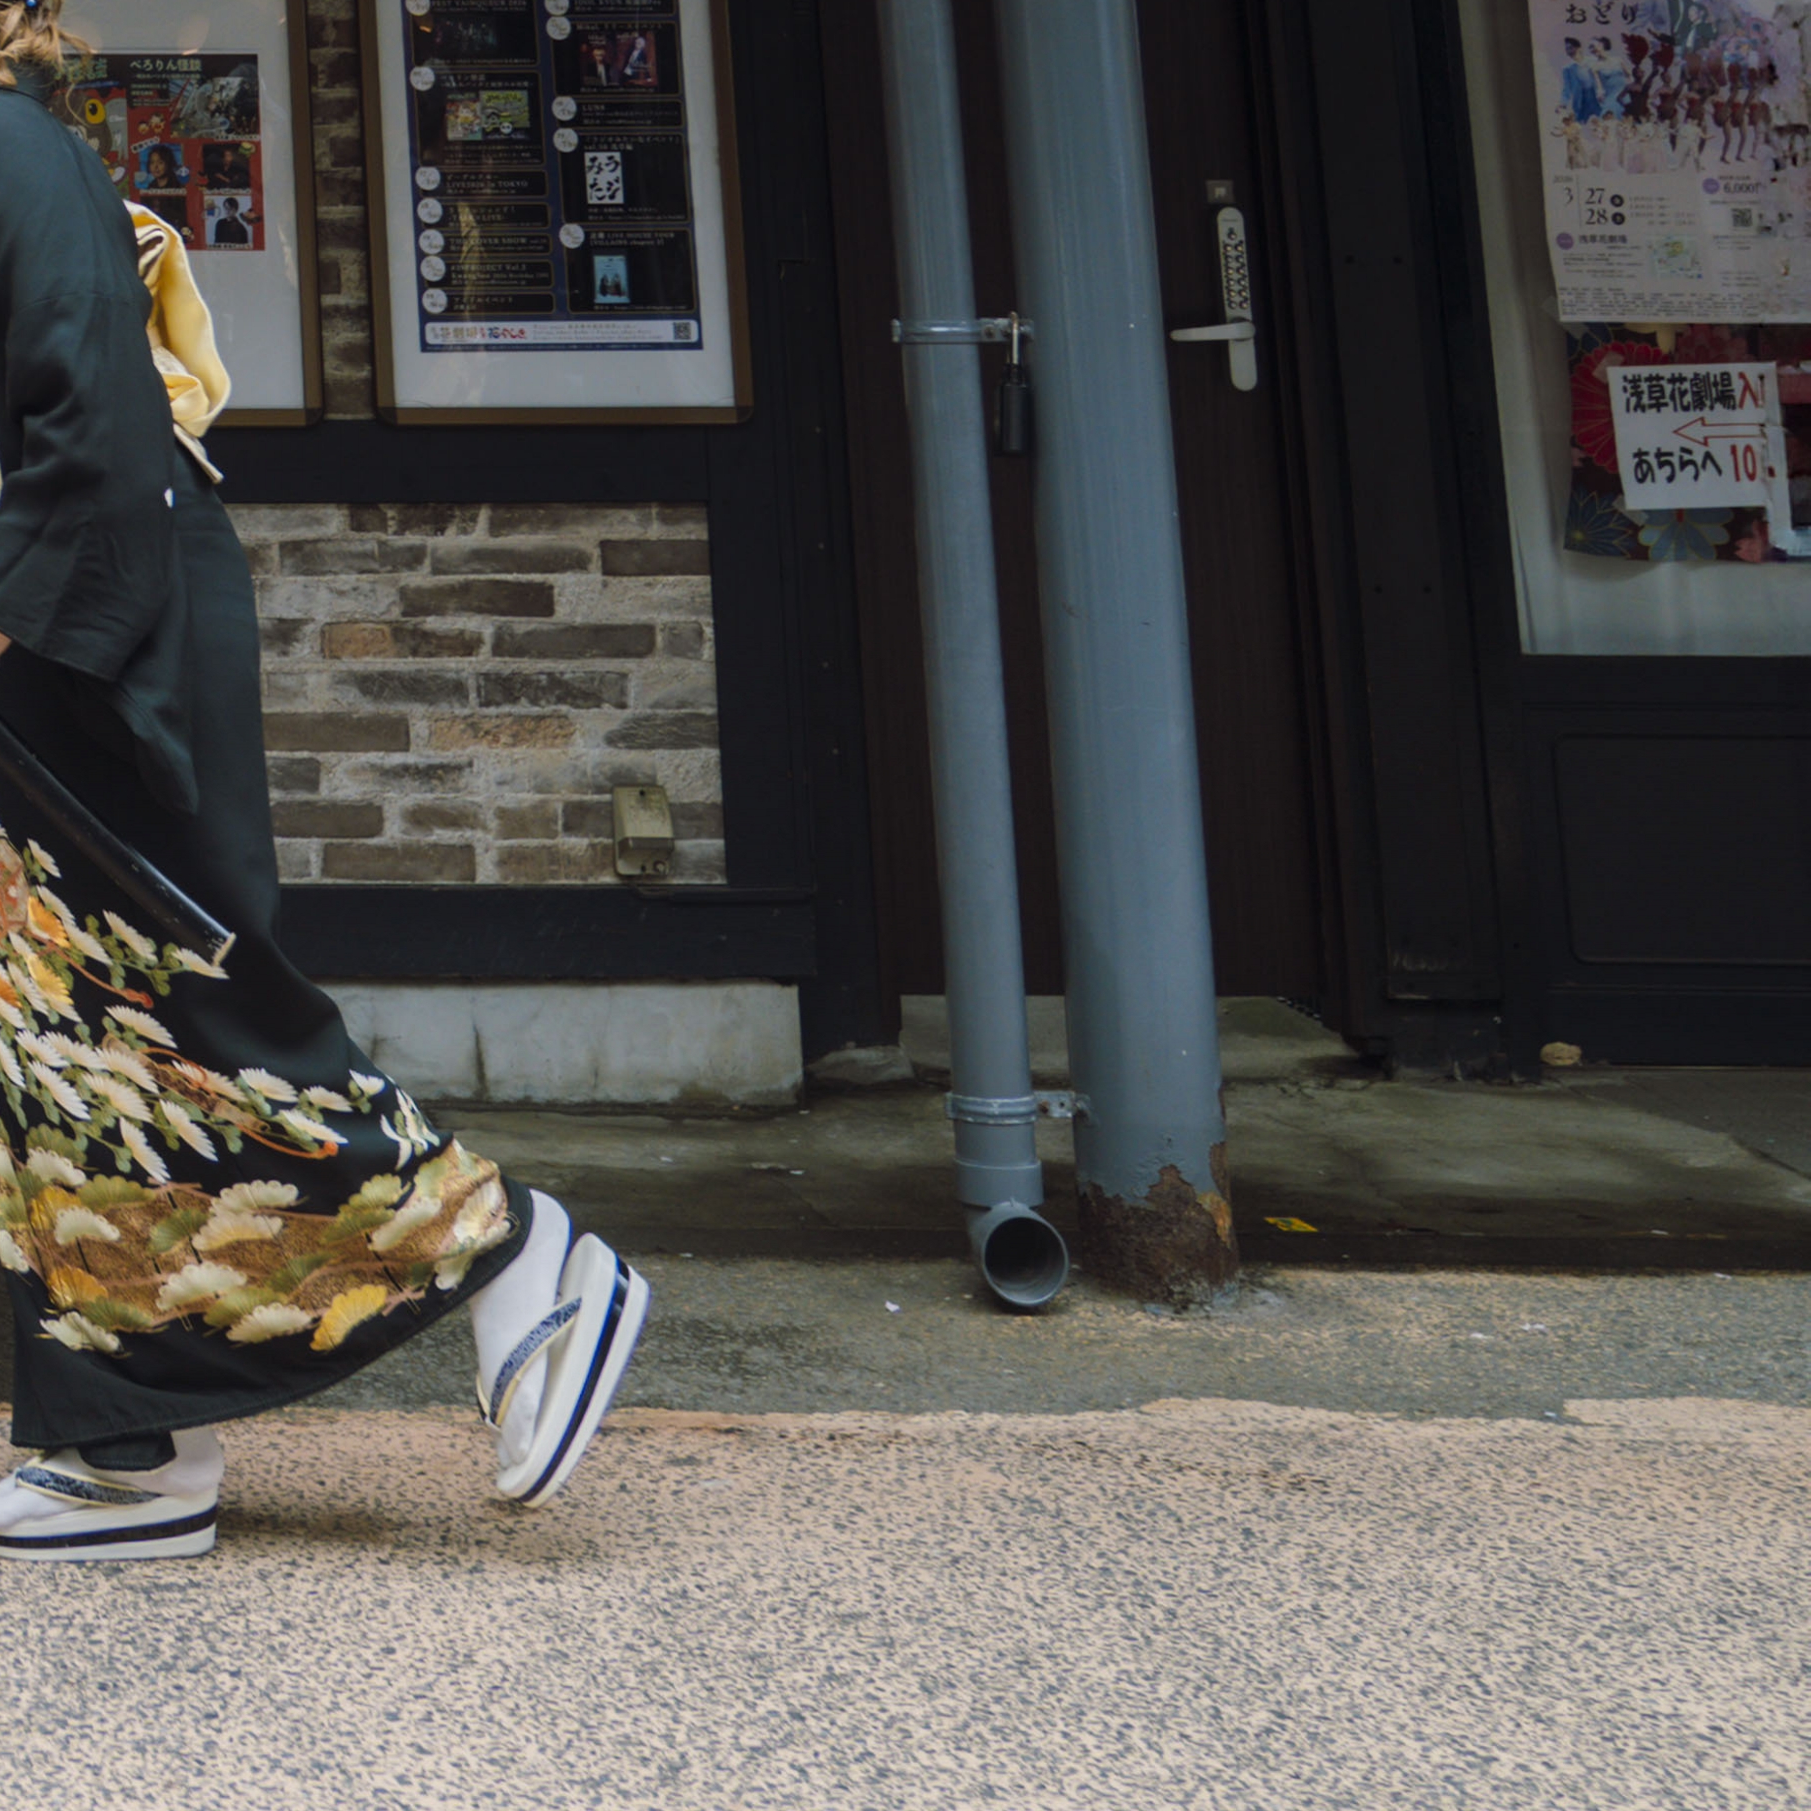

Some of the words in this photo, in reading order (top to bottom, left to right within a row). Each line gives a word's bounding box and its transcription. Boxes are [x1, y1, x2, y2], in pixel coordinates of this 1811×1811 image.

[1565, 0, 1640, 25] おどり
[1585, 188, 1605, 205] 27
[1585, 208, 1608, 226] 28
[1622, 371, 1765, 413] 浅草花劇場入
[1633, 446, 1723, 485] あちらへ
